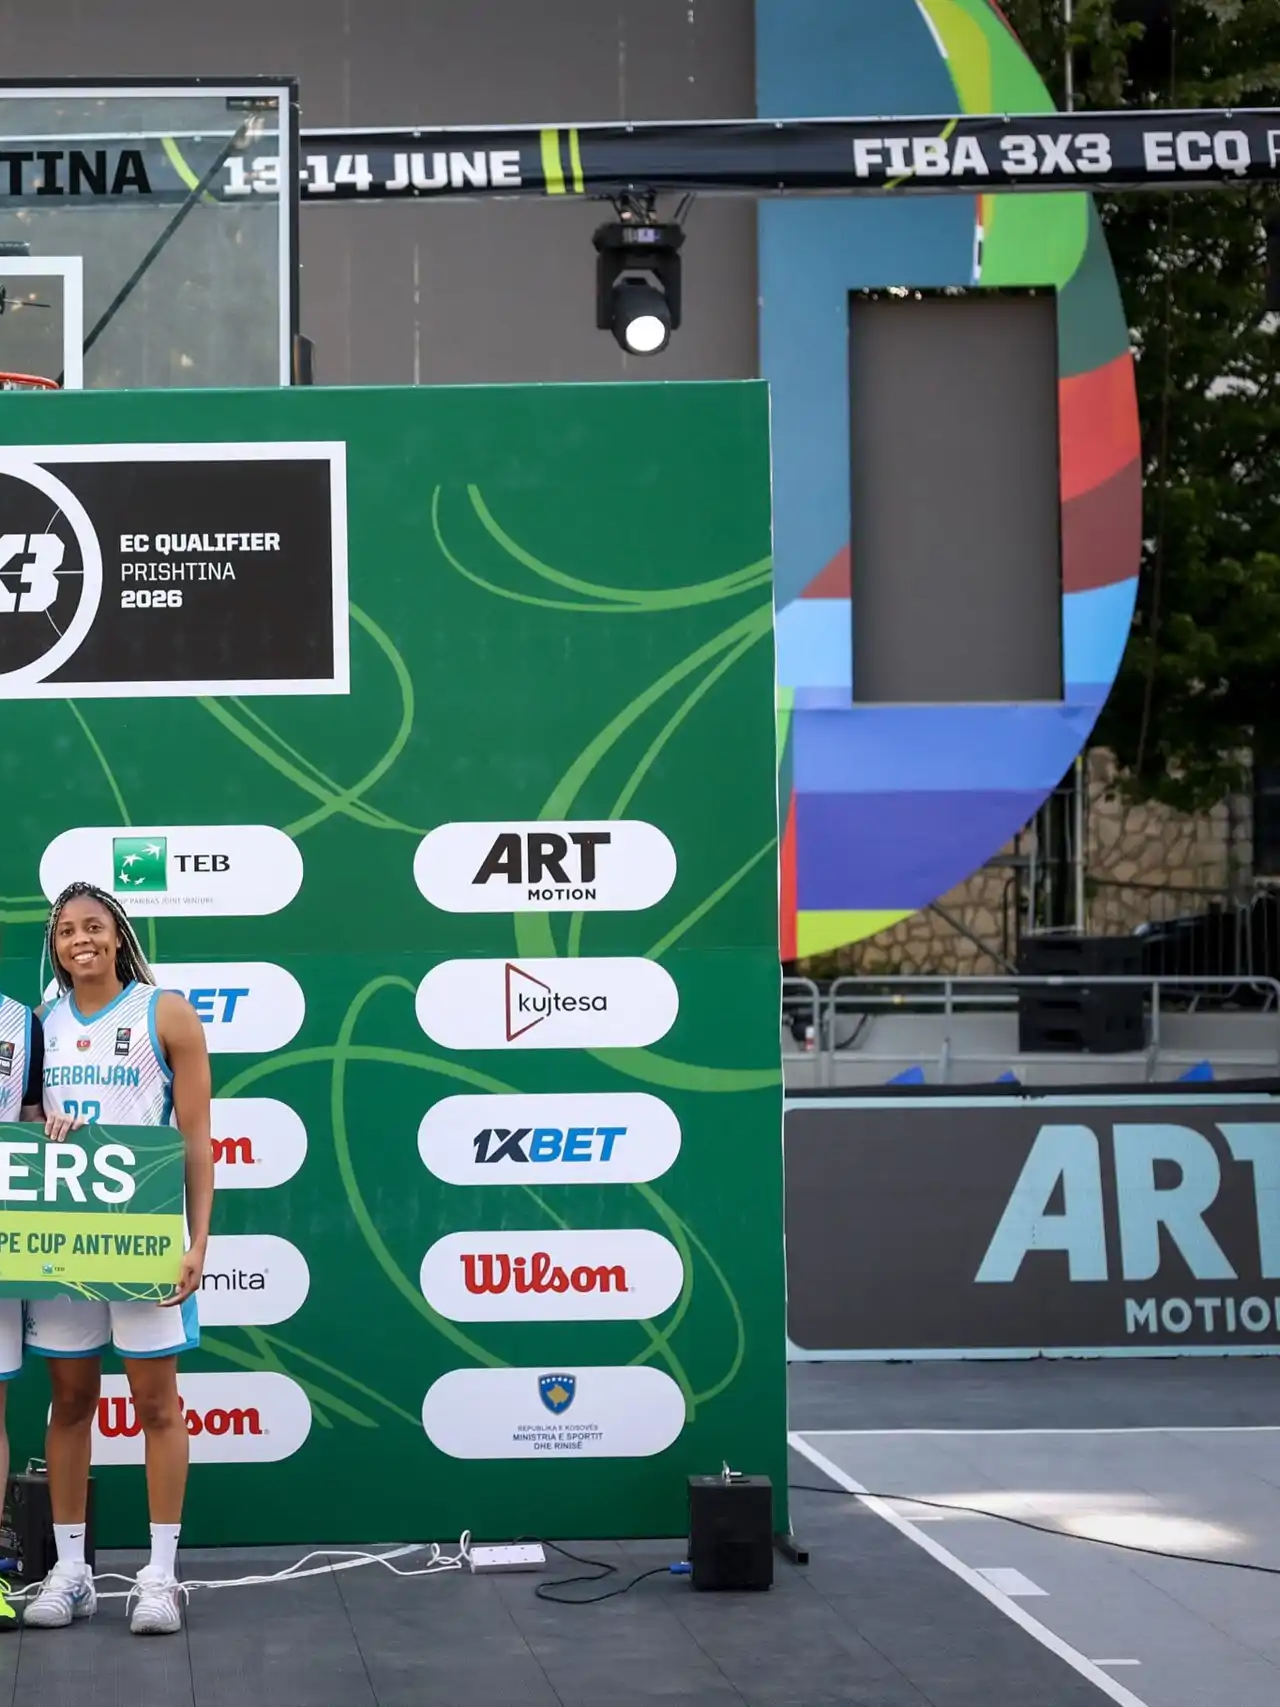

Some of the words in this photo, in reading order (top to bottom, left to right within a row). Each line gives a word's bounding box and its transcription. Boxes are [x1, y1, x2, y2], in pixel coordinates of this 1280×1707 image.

[853, 135, 989, 177] FIBA
[1000, 132, 1113, 175] 3X3
[1142, 129, 1252, 175] ECQ
[385, 150, 522, 190] JUNE
[121, 534, 149, 552] EC
[155, 532, 280, 556] QUALIFIER
[121, 562, 236, 581] PRISHTINA
[121, 589, 183, 609] 2026
[174, 855, 230, 872] TEB
[471, 832, 611, 884] ART
[528, 889, 596, 900] MOTION
[518, 992, 608, 1017] kujtesa
[43, 1065, 140, 1088] ZERBAIJAN
[473, 1127, 627, 1164] 1XBET
[26, 1232, 67, 1255] CUP
[72, 1233, 172, 1257] ANTWERP
[202, 1268, 267, 1291] mita
[459, 1252, 629, 1294] Wilson
[1125, 1296, 1280, 1334] MOTIO
[98, 1394, 263, 1438] Wson
[513, 1433, 557, 1441] MINISTRIA
[566, 1432, 604, 1440] SPORTIT
[534, 1442, 552, 1450] DHE
